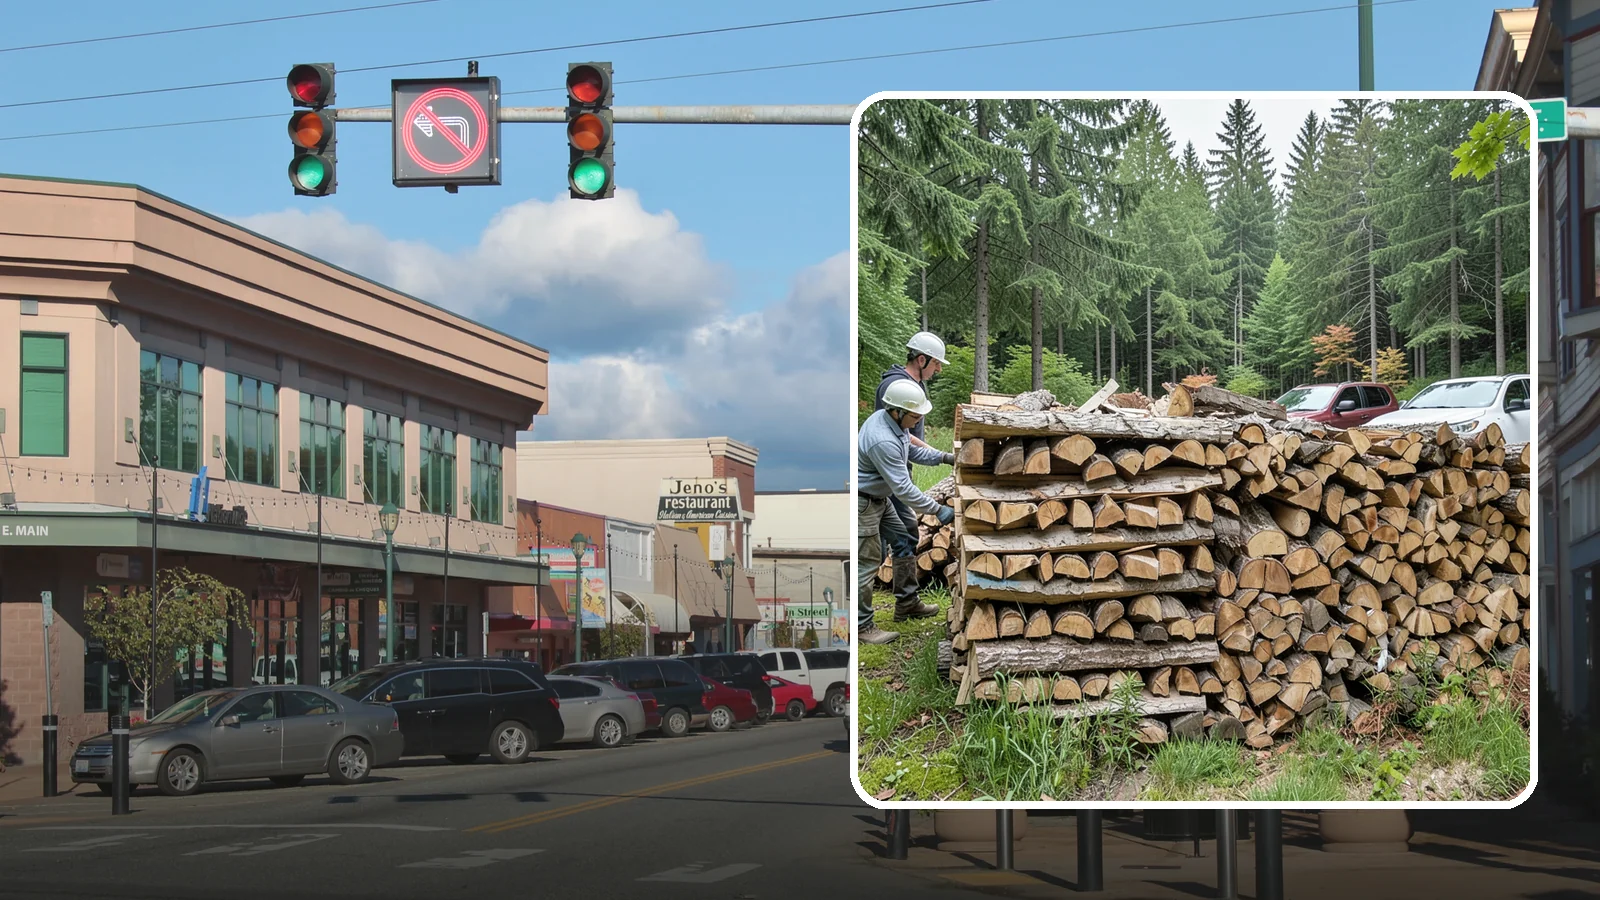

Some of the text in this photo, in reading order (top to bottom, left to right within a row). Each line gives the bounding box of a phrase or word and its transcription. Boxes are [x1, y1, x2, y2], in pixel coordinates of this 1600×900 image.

[670, 480, 727, 494] Jeno's
[665, 496, 731, 509] restaurant
[659, 510, 681, 519] Italian
[686, 510, 714, 519] American
[715, 509, 737, 519] Cuisine
[2, 525, 49, 536] E. MAIN
[798, 608, 828, 616] Street
[790, 619, 823, 627] lass
